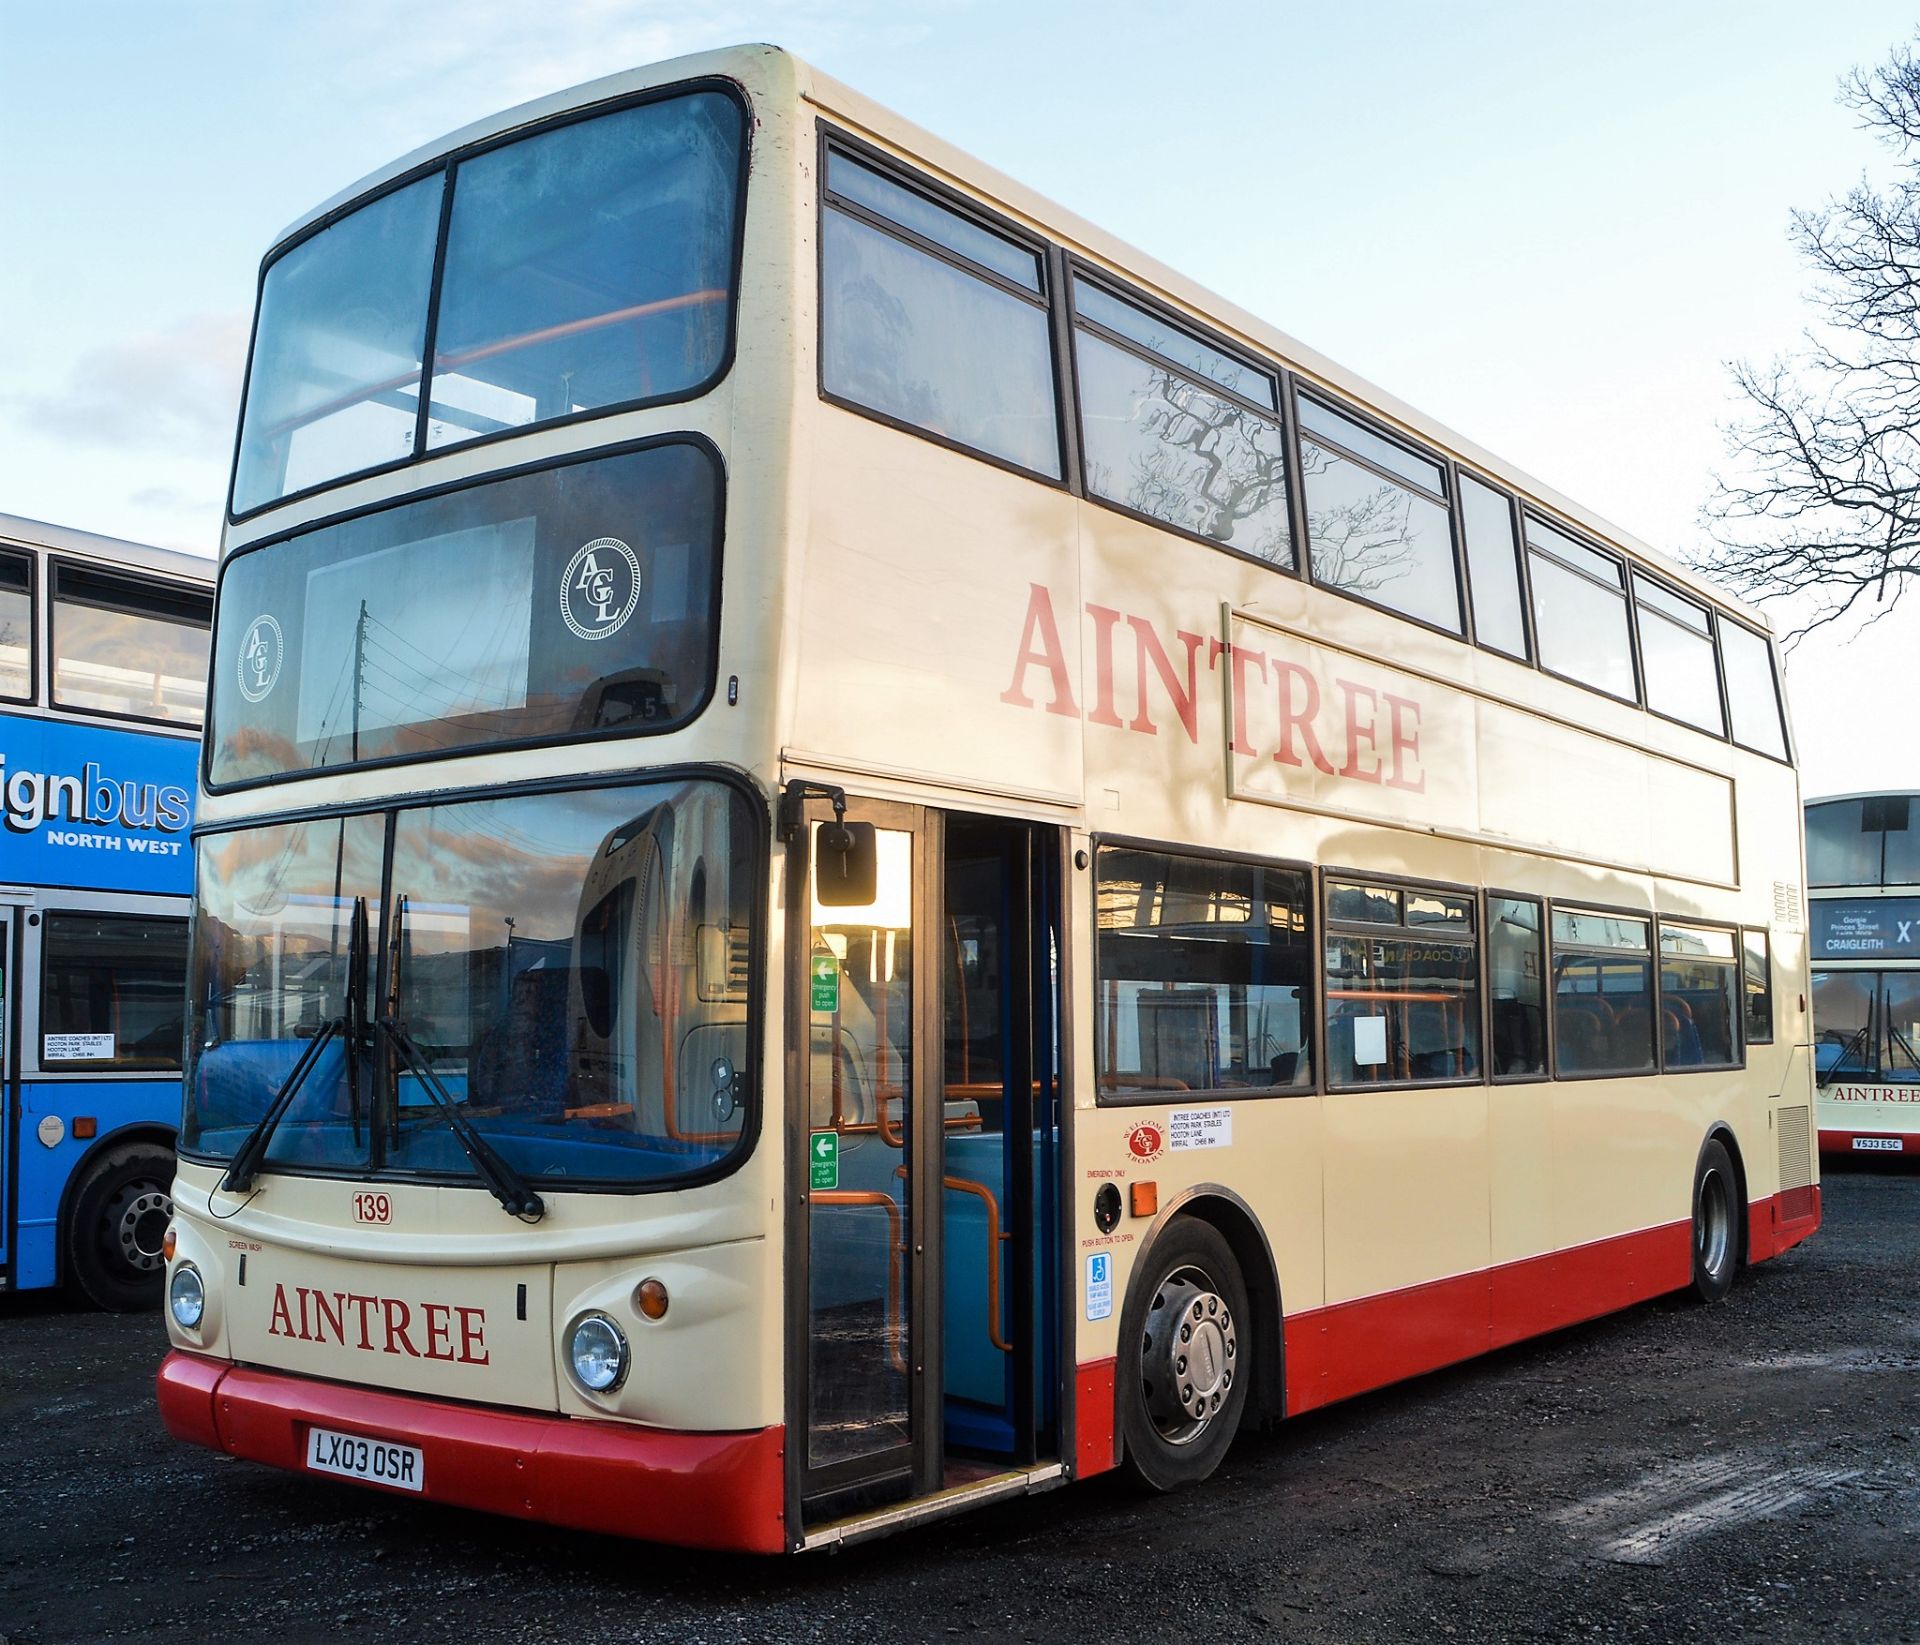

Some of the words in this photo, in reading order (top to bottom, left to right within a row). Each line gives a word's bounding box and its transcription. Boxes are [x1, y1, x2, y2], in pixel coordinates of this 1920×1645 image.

[1000, 582, 1426, 794] AINTREE
[47, 831, 121, 851] NORTH
[126, 838, 182, 856] WEST
[1843, 917, 1867, 925] Gorgie
[1826, 939, 1884, 950] CRAIGLEITH
[812, 984, 837, 992] Emergency
[1834, 1087, 1920, 1102] AINTREE
[1190, 1112, 1210, 1120] COACHES
[1123, 1120, 1166, 1139] WELCOME
[1191, 1121, 1202, 1129] PARK
[1203, 1119, 1222, 1128] STABLES
[1856, 1139, 1879, 1148] V533
[1881, 1140, 1899, 1149] ESC
[1124, 1149, 1164, 1164] ABOARD
[811, 1161, 836, 1169] Emergency
[818, 1169, 830, 1177] push
[1087, 1170, 1112, 1178] EMERGENCY
[355, 1194, 389, 1222] 139
[1095, 1236, 1113, 1246] BUTTON
[1114, 1235, 1121, 1243] TO
[1121, 1233, 1134, 1242] OPEN
[228, 1240, 247, 1250] SCREEN
[249, 1243, 263, 1252] WASH
[268, 1283, 490, 1366] AINTREE
[316, 1433, 369, 1472] LX03
[373, 1445, 414, 1483] OSR
